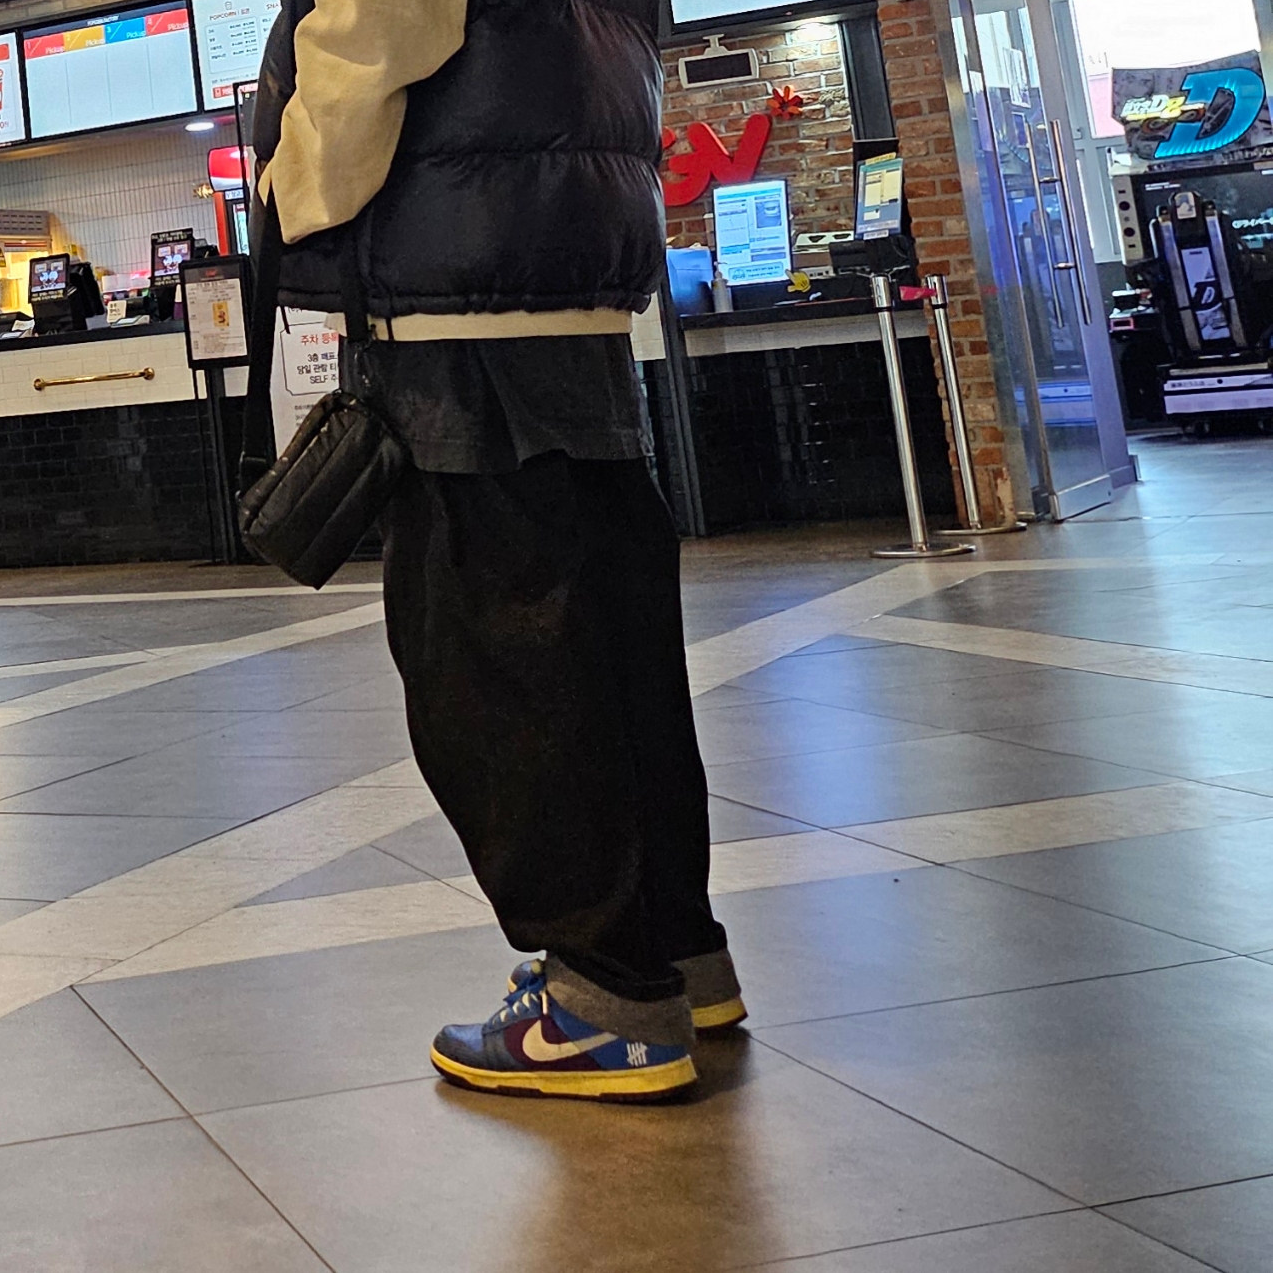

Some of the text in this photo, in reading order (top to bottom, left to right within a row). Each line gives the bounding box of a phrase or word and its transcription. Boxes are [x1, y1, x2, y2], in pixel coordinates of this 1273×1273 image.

[209, 11, 237, 21] POPCORN
[167, 22, 189, 31] Pickup
[126, 30, 147, 39] Pickup
[85, 38, 105, 47] Pickup
[45, 45, 66, 55] Pickup
[300, 334, 319, 346] 주차
[309, 375, 329, 384] SELF
